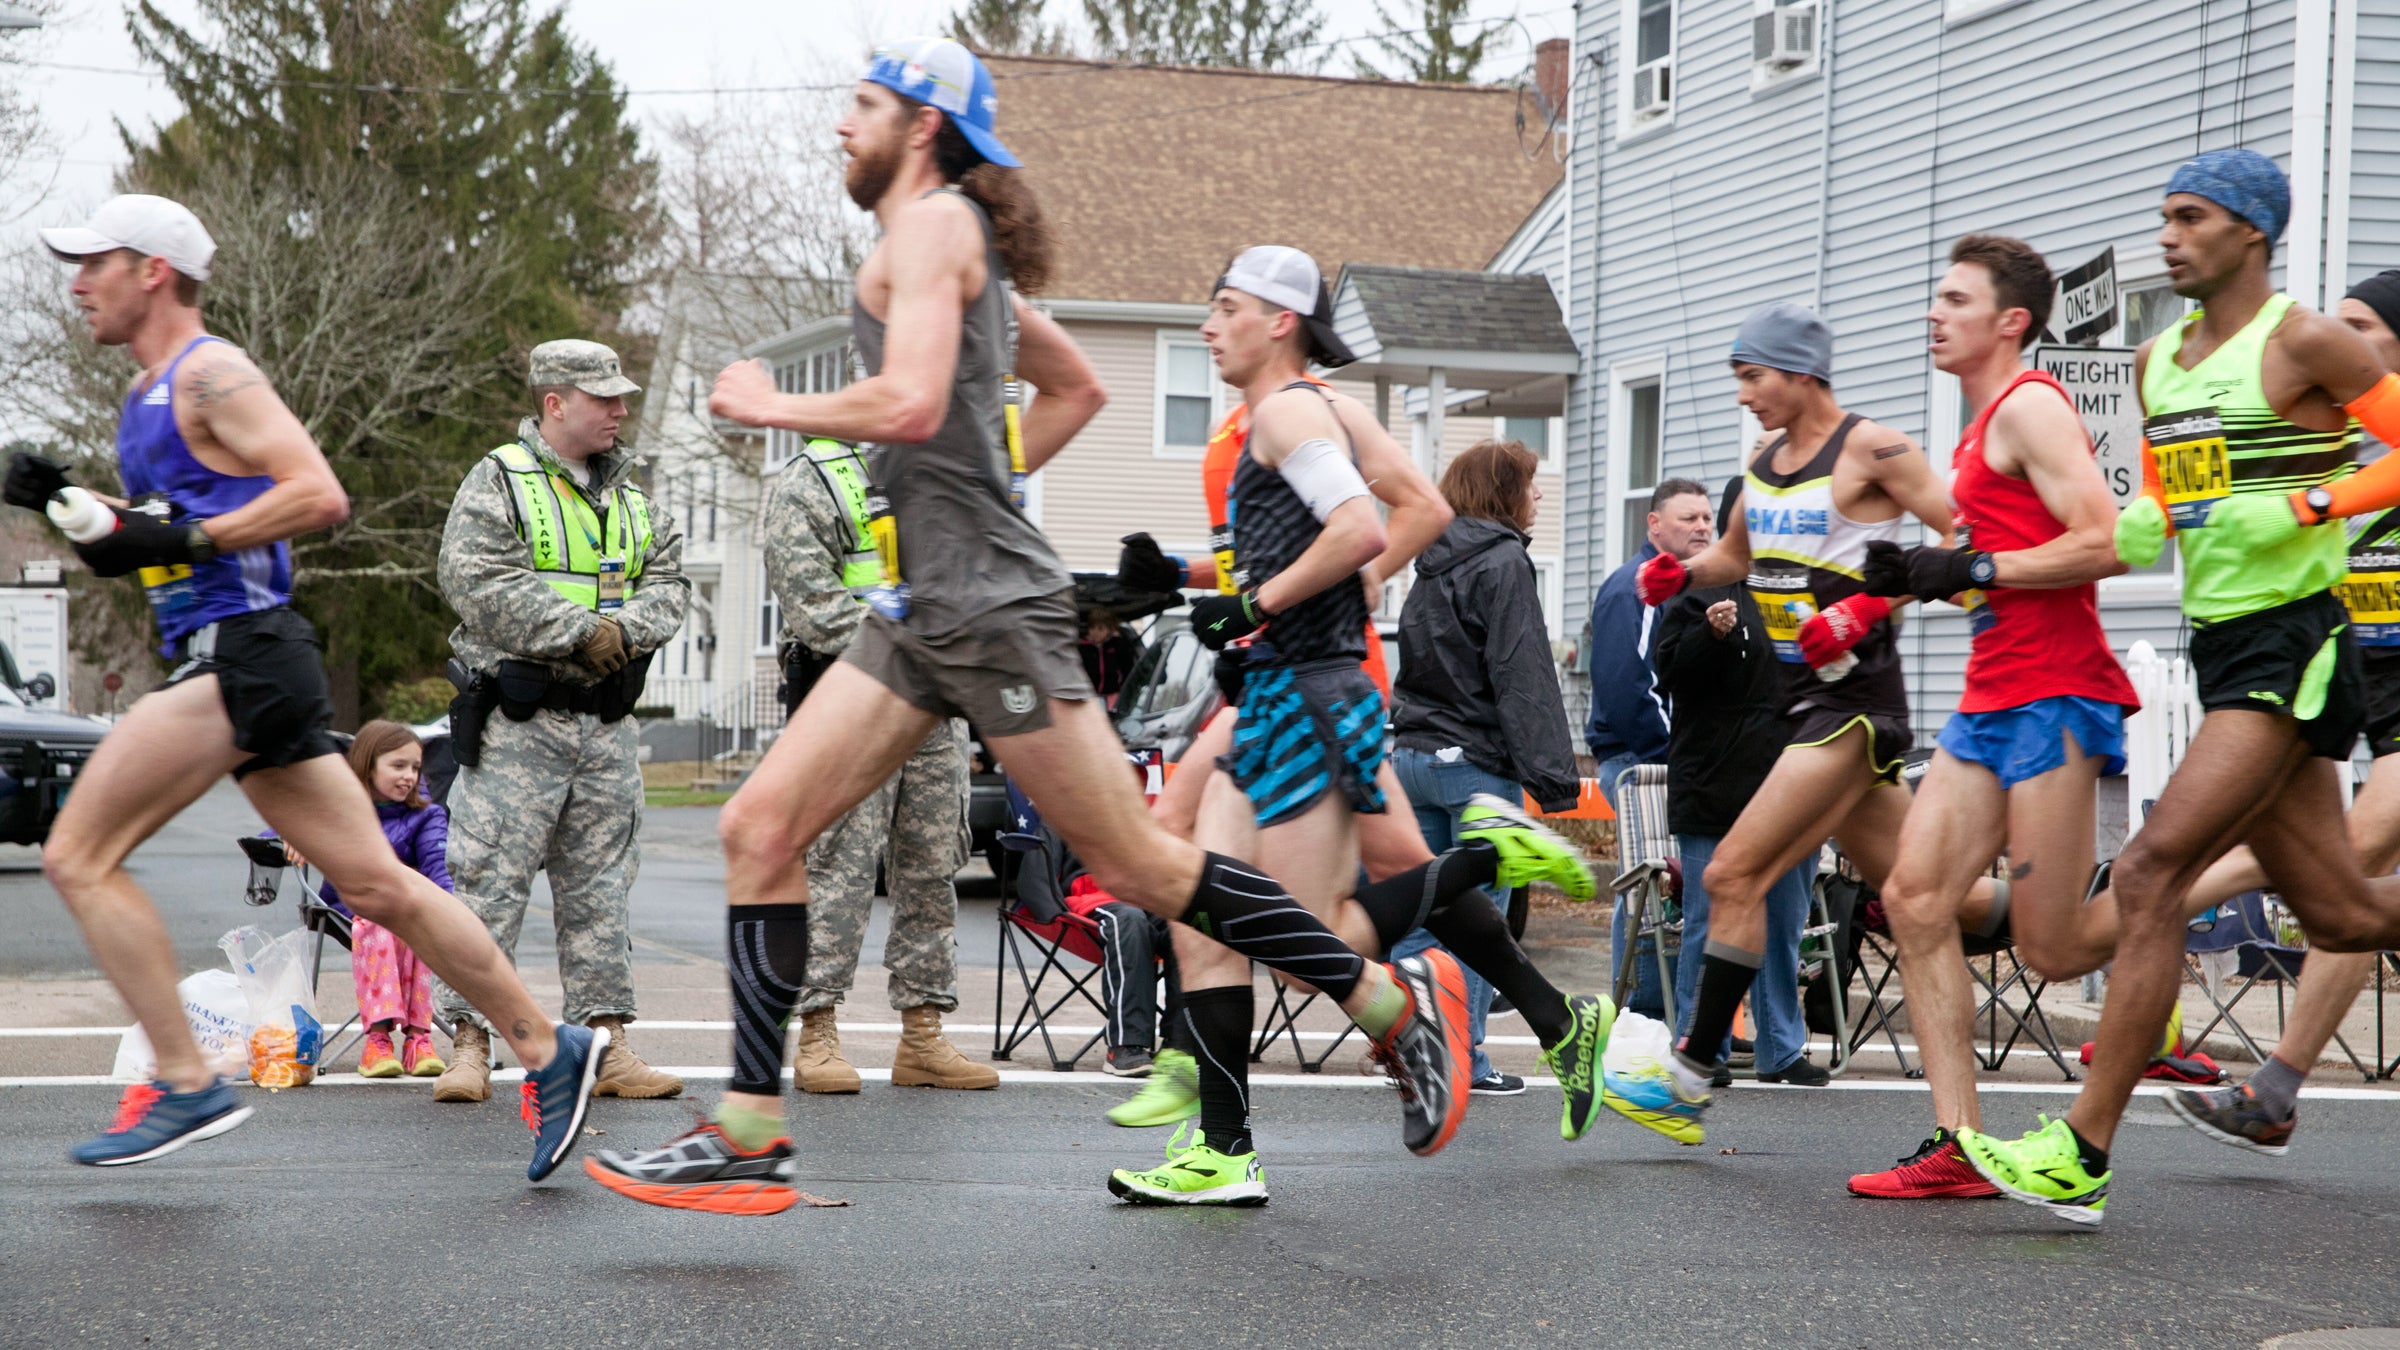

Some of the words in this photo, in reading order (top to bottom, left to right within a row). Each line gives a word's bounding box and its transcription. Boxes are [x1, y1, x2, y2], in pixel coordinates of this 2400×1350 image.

[2065, 288, 2093, 324] ONE
[2094, 278, 2113, 308] WAY
[2046, 361, 2133, 384] WEIGHT
[2075, 393, 2121, 415] IMIT
[2156, 444, 2225, 495] ANCA
[524, 479, 551, 560] MILITARY
[1746, 507, 1793, 535] OKA
[1568, 999, 1599, 1093] Reebok
